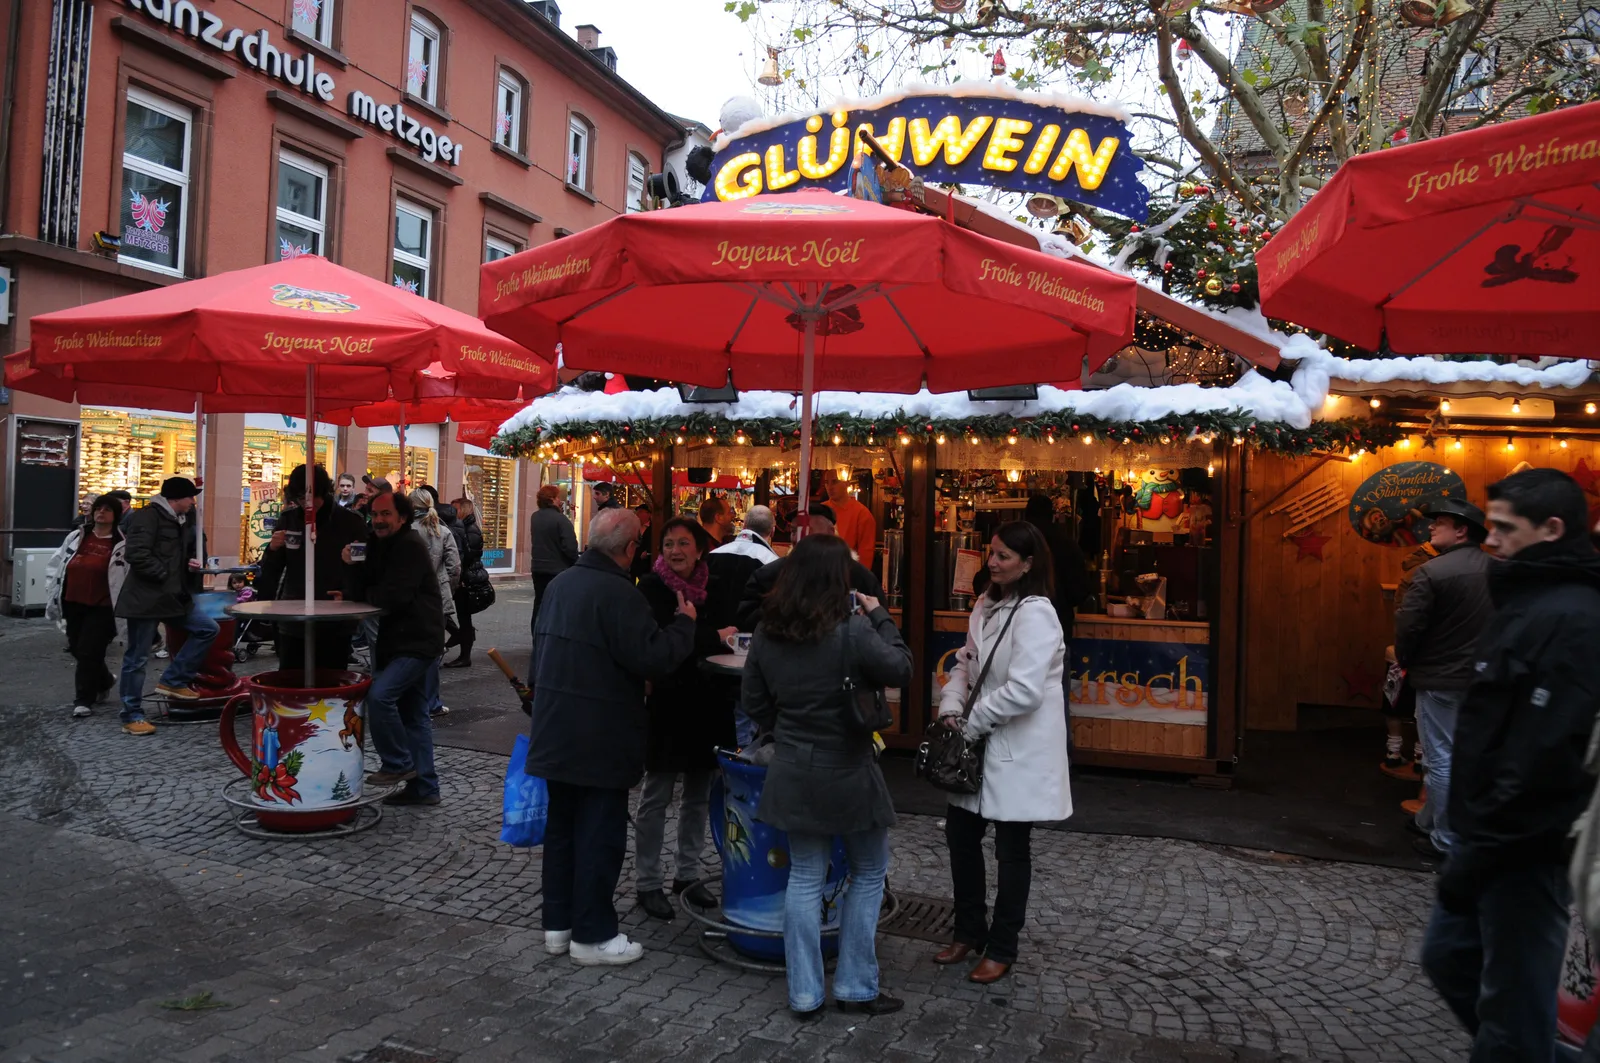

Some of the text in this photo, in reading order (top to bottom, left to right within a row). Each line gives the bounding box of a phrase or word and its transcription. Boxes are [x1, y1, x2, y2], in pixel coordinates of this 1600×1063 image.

[130, 0, 463, 166] anzschule metzger
[714, 110, 1120, 203] GLÜHWEIN
[1405, 136, 1600, 203] Frohe Weihna
[125, 233, 169, 254] METZGER
[711, 237, 865, 270] Joyeux Noël
[1275, 213, 1321, 276] Joyeux Noël
[494, 256, 592, 303] Frohe Weihnachten
[978, 257, 1106, 314] Frohe Weihnachten
[53, 330, 163, 353] Frohe Weihnachten
[261, 332, 377, 356] Joyeux Noël
[459, 344, 542, 375] Frohe Weihnachten
[1379, 471, 1442, 486] Dornfelder
